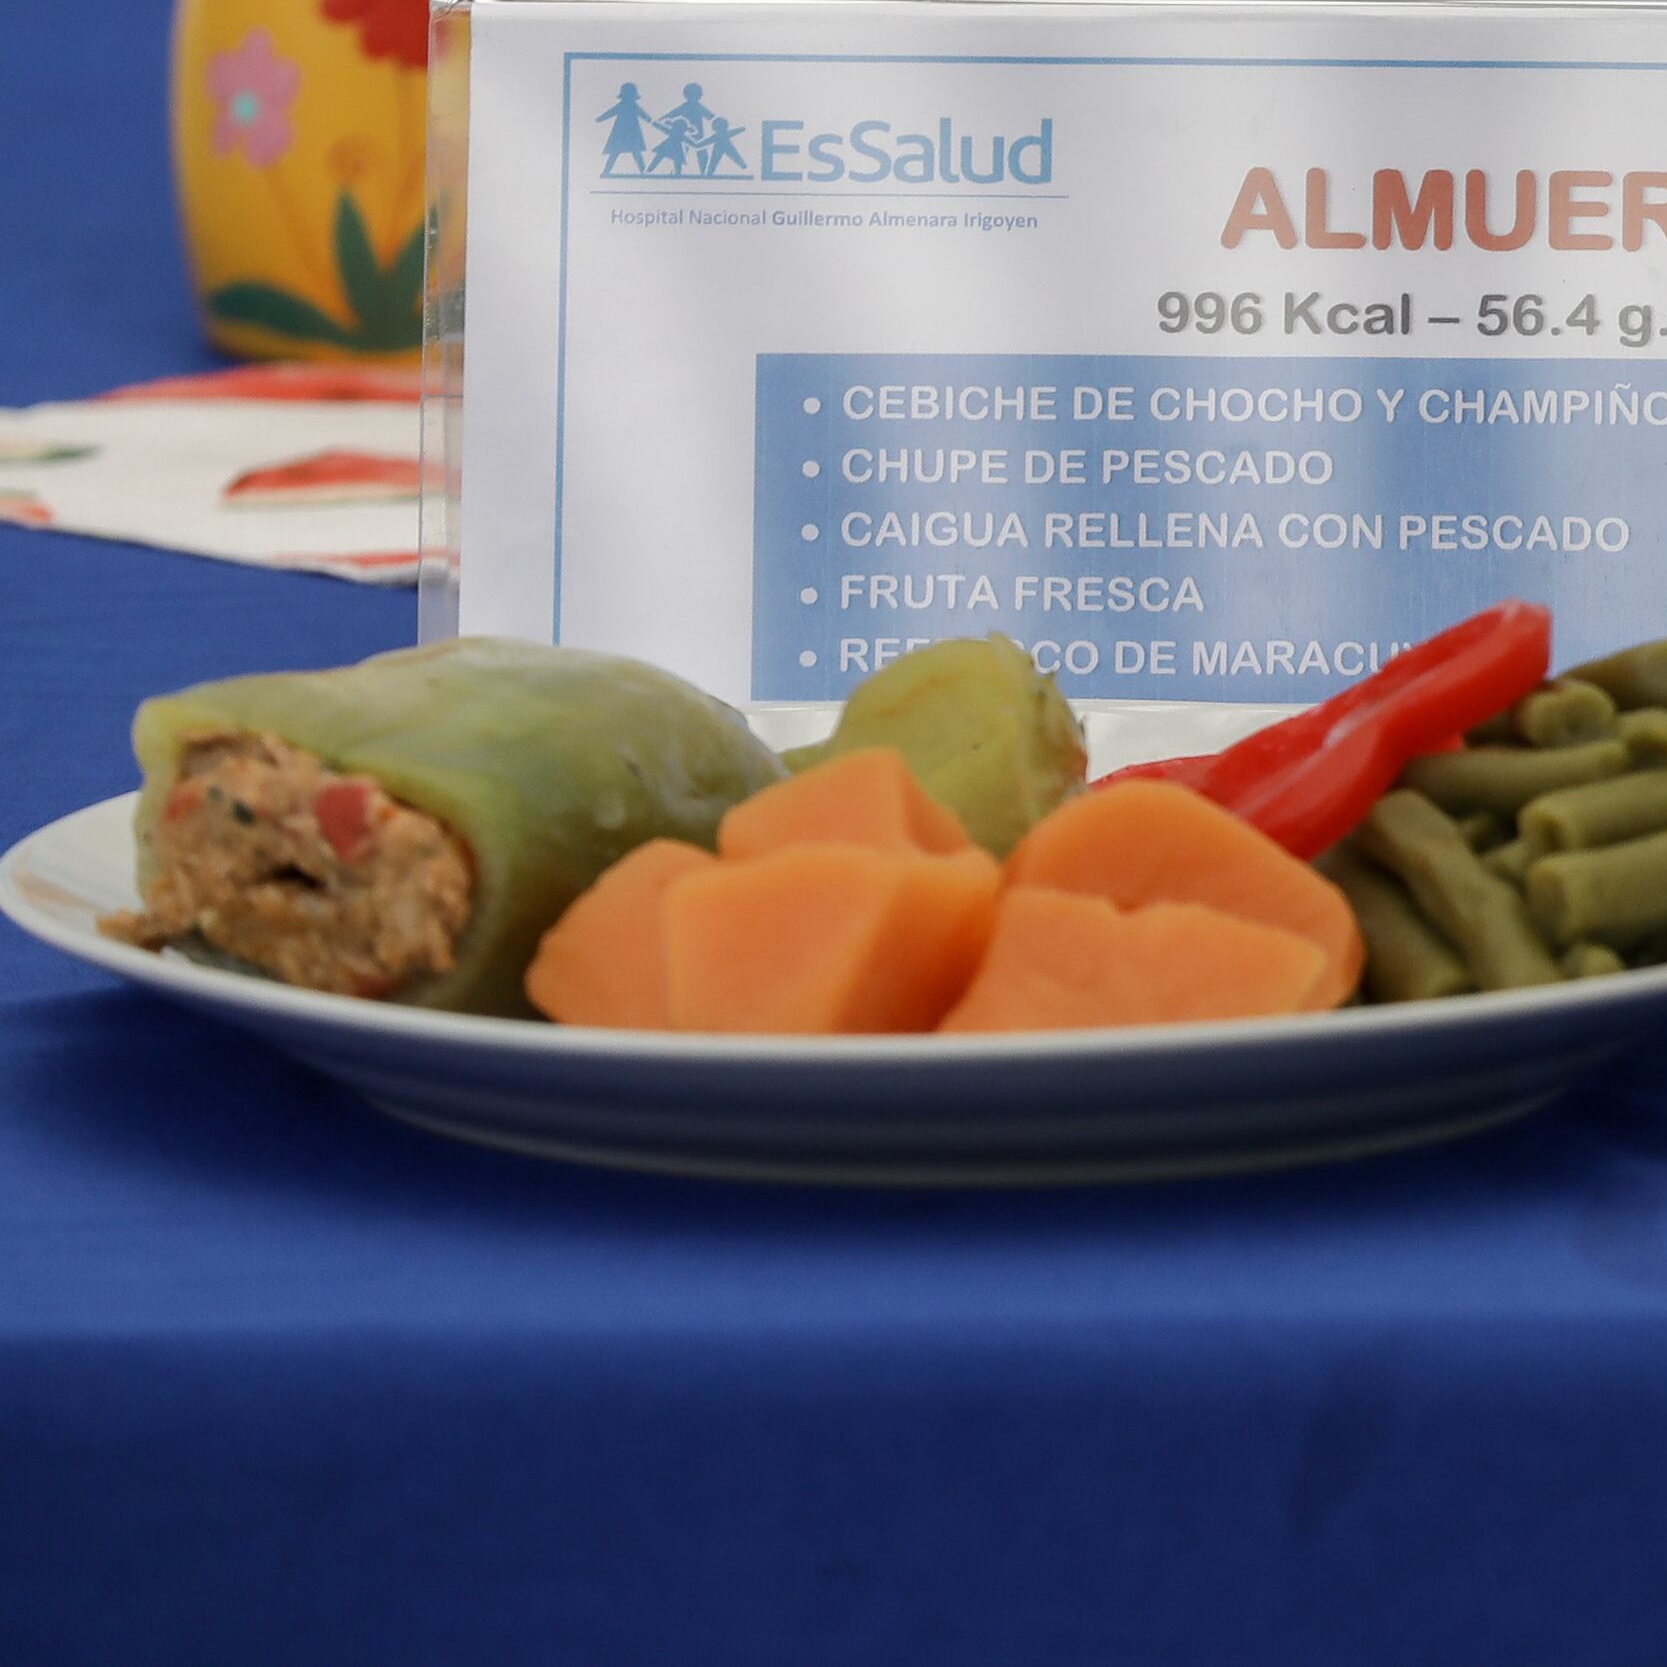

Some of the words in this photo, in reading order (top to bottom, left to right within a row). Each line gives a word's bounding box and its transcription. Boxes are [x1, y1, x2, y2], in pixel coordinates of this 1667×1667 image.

[760, 116, 1054, 185] EsSalud
[610, 208, 684, 228] Hospital
[688, 209, 767, 226] Nacional
[771, 209, 864, 227] Guillermo
[868, 210, 958, 228] Almenara
[963, 211, 1039, 232] Irigoyen
[1157, 291, 1264, 335] 996
[1284, 291, 1412, 336] Kcal
[1476, 293, 1601, 337] 56.4
[842, 384, 1057, 421] CEBICHE
[1073, 386, 1135, 421] DE
[1150, 387, 1362, 423] CHOCHO
[1372, 389, 1403, 423] Y
[841, 447, 1008, 484] CHUPE
[1024, 449, 1086, 484] DE
[1102, 449, 1333, 485] PESCADO
[841, 511, 1028, 548] CAIGUA
[1044, 512, 1264, 549] RELLENA
[1278, 512, 1382, 550] CON
[1399, 514, 1629, 552] PESCADO
[840, 574, 999, 610] FRUTA
[1014, 575, 1204, 613] FRESCA
[1114, 640, 1176, 675] DE
[1193, 641, 1412, 676] MARACU
